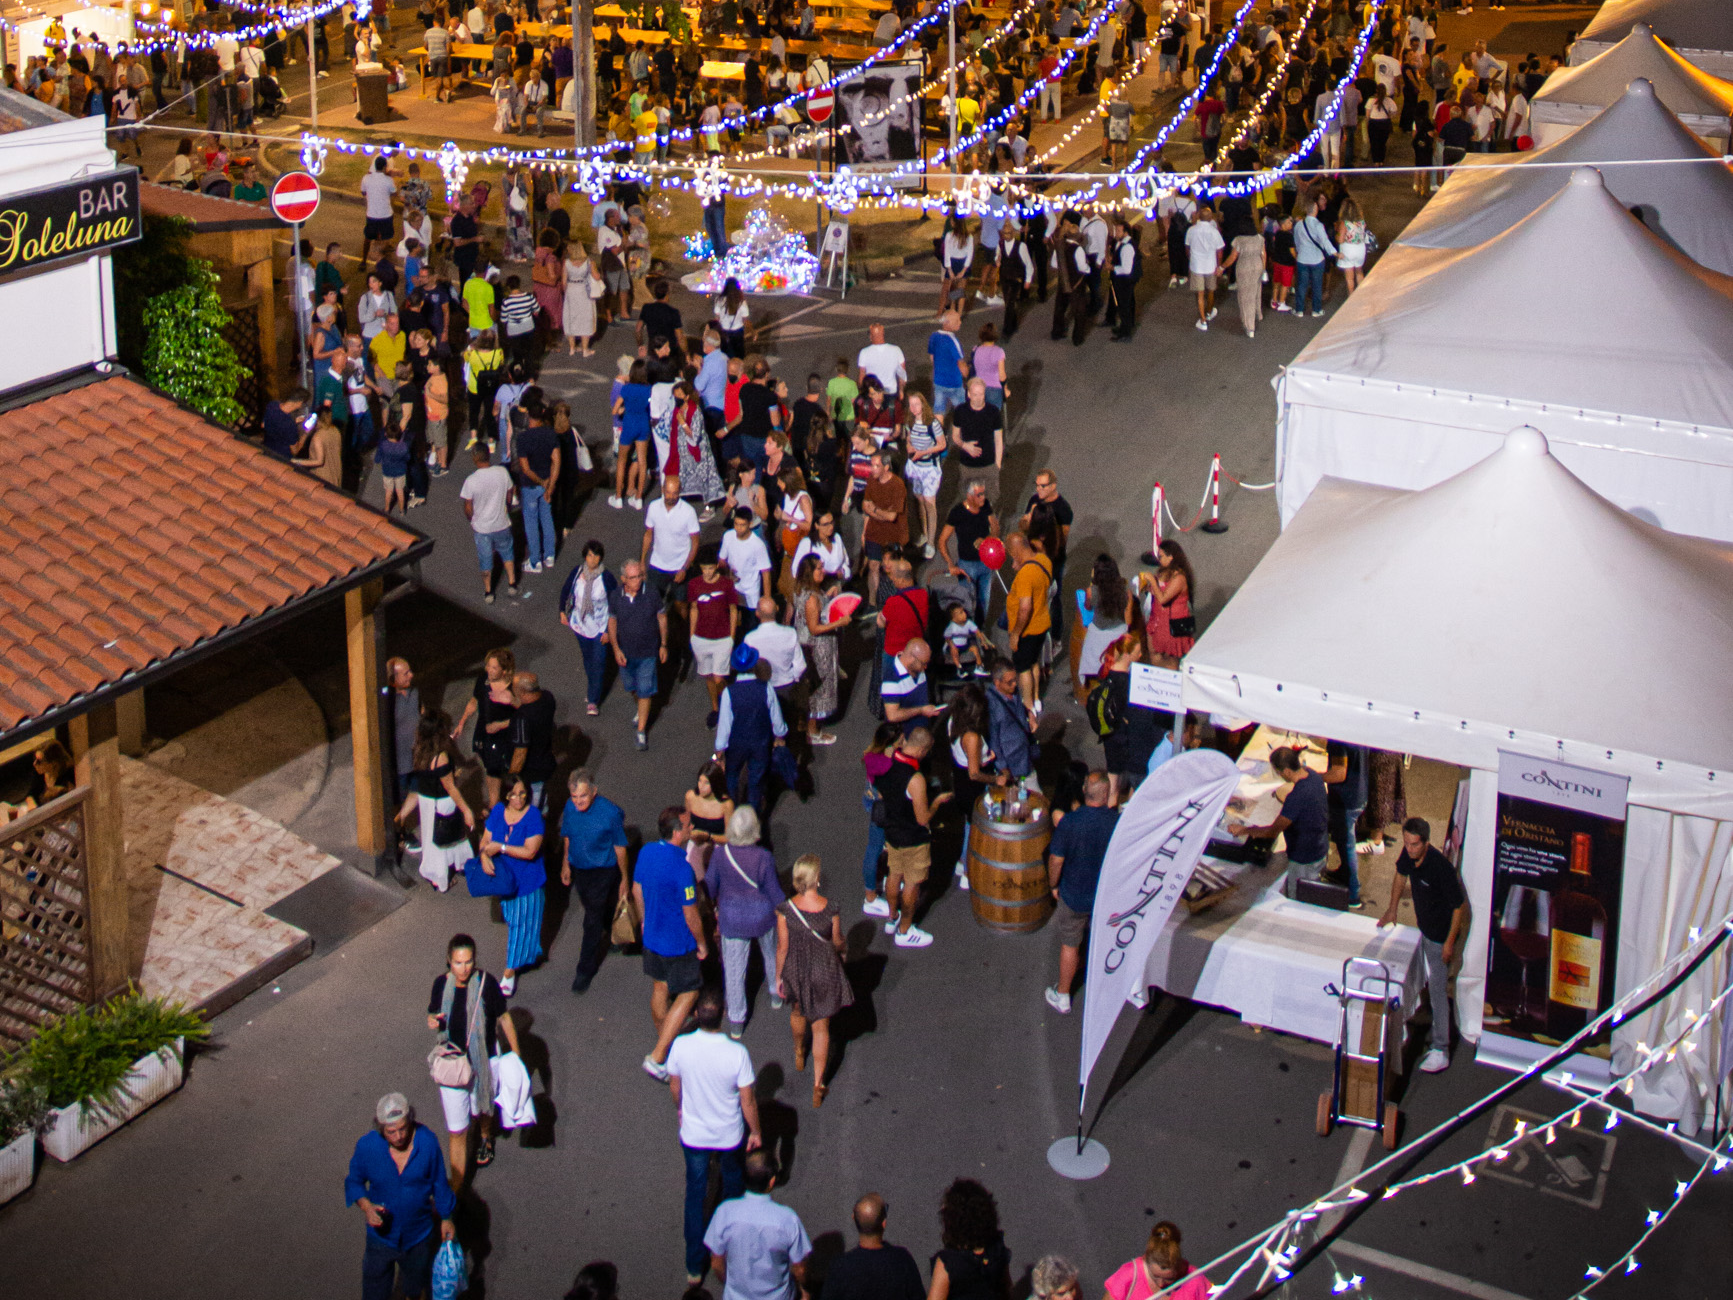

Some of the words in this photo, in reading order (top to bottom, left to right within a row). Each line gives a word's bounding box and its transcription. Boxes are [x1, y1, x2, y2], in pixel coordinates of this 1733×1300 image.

[79, 181, 129, 219] BAR
[0, 210, 134, 268] Soleluna
[1521, 770, 1602, 798] CONTINI
[1160, 873, 1184, 911] 1898
